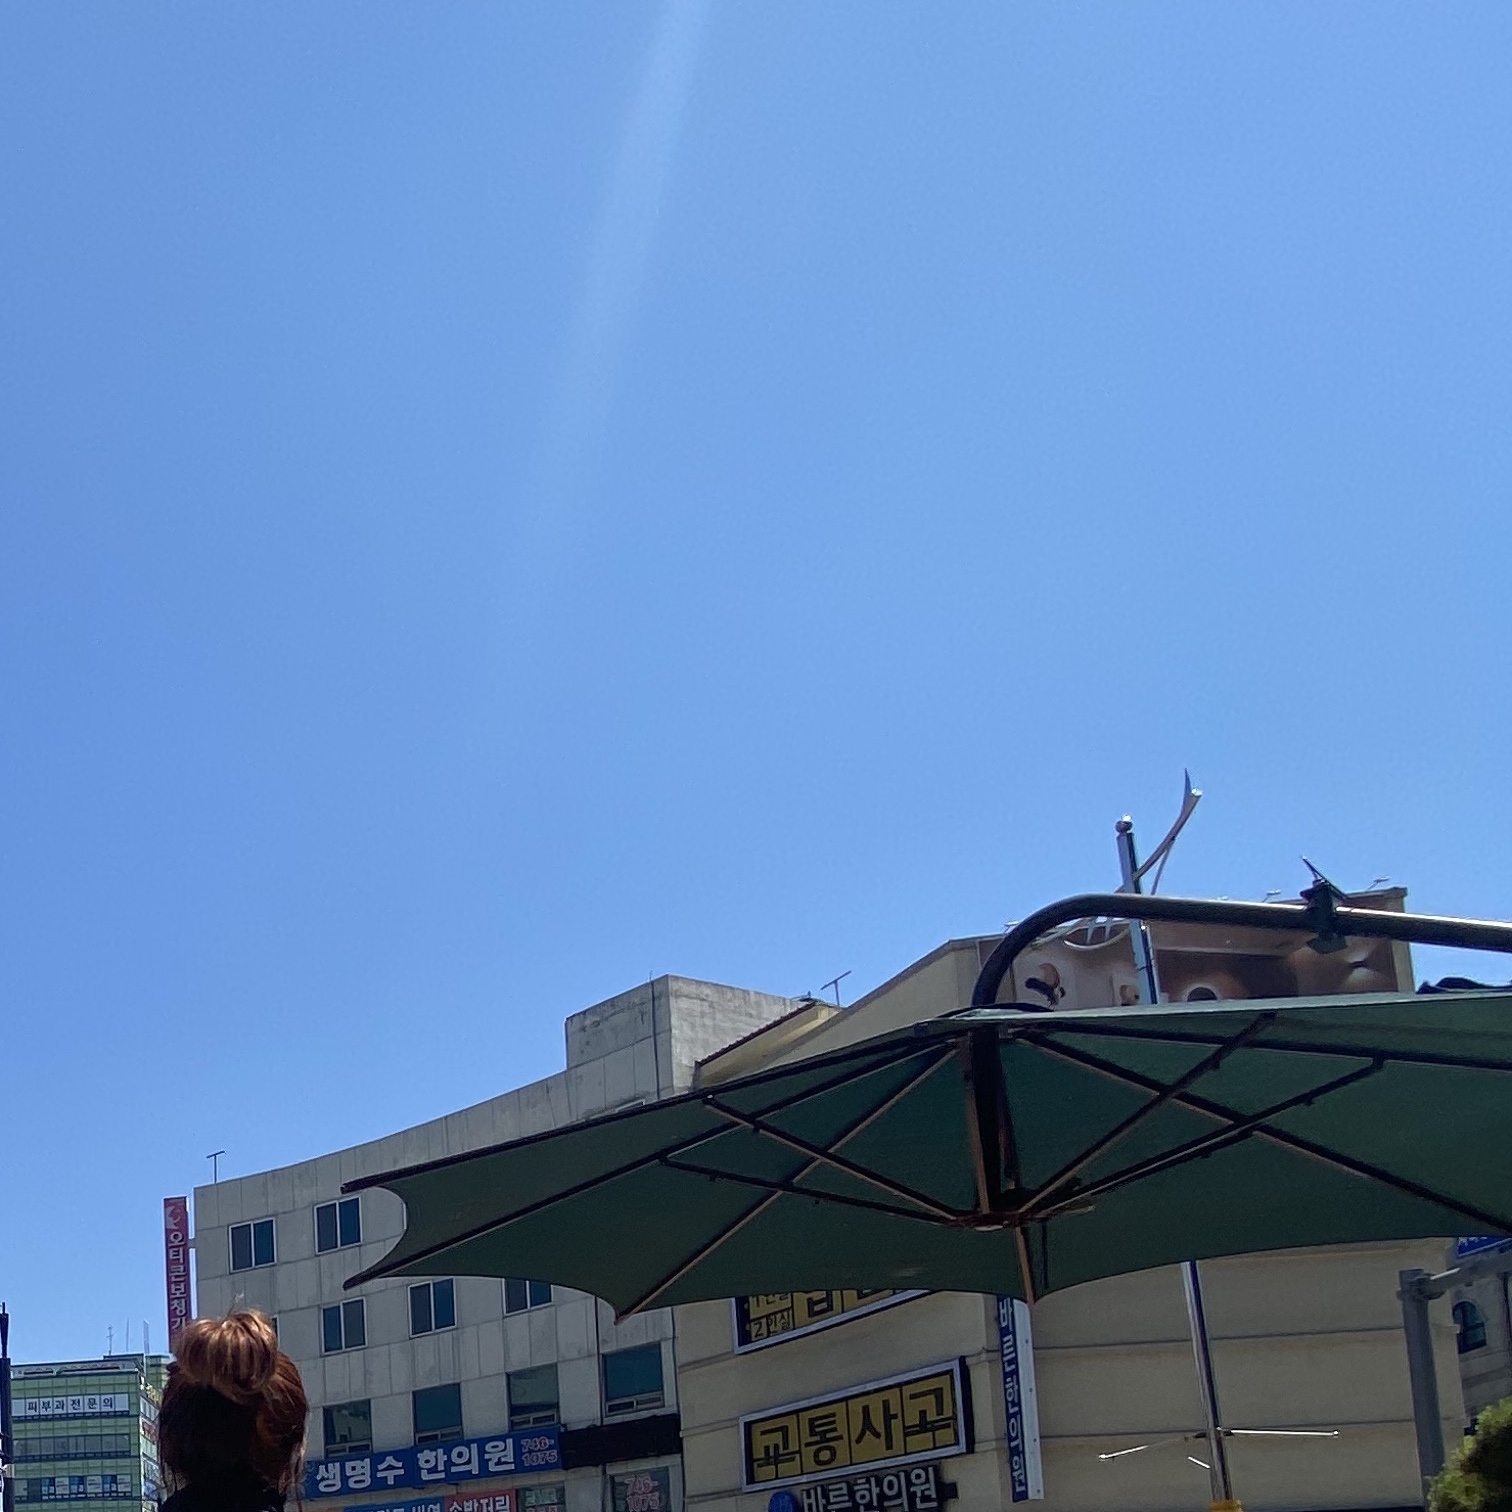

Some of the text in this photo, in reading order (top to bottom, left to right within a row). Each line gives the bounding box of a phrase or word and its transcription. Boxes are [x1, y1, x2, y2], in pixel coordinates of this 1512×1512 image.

[168, 1231, 187, 1332] 오티콘보청기
[28, 1397, 113, 1413] 피부과전문의
[753, 1386, 955, 1468] 교통사고
[317, 1456, 405, 1493] 생명수
[417, 1438, 515, 1480] 한의원
